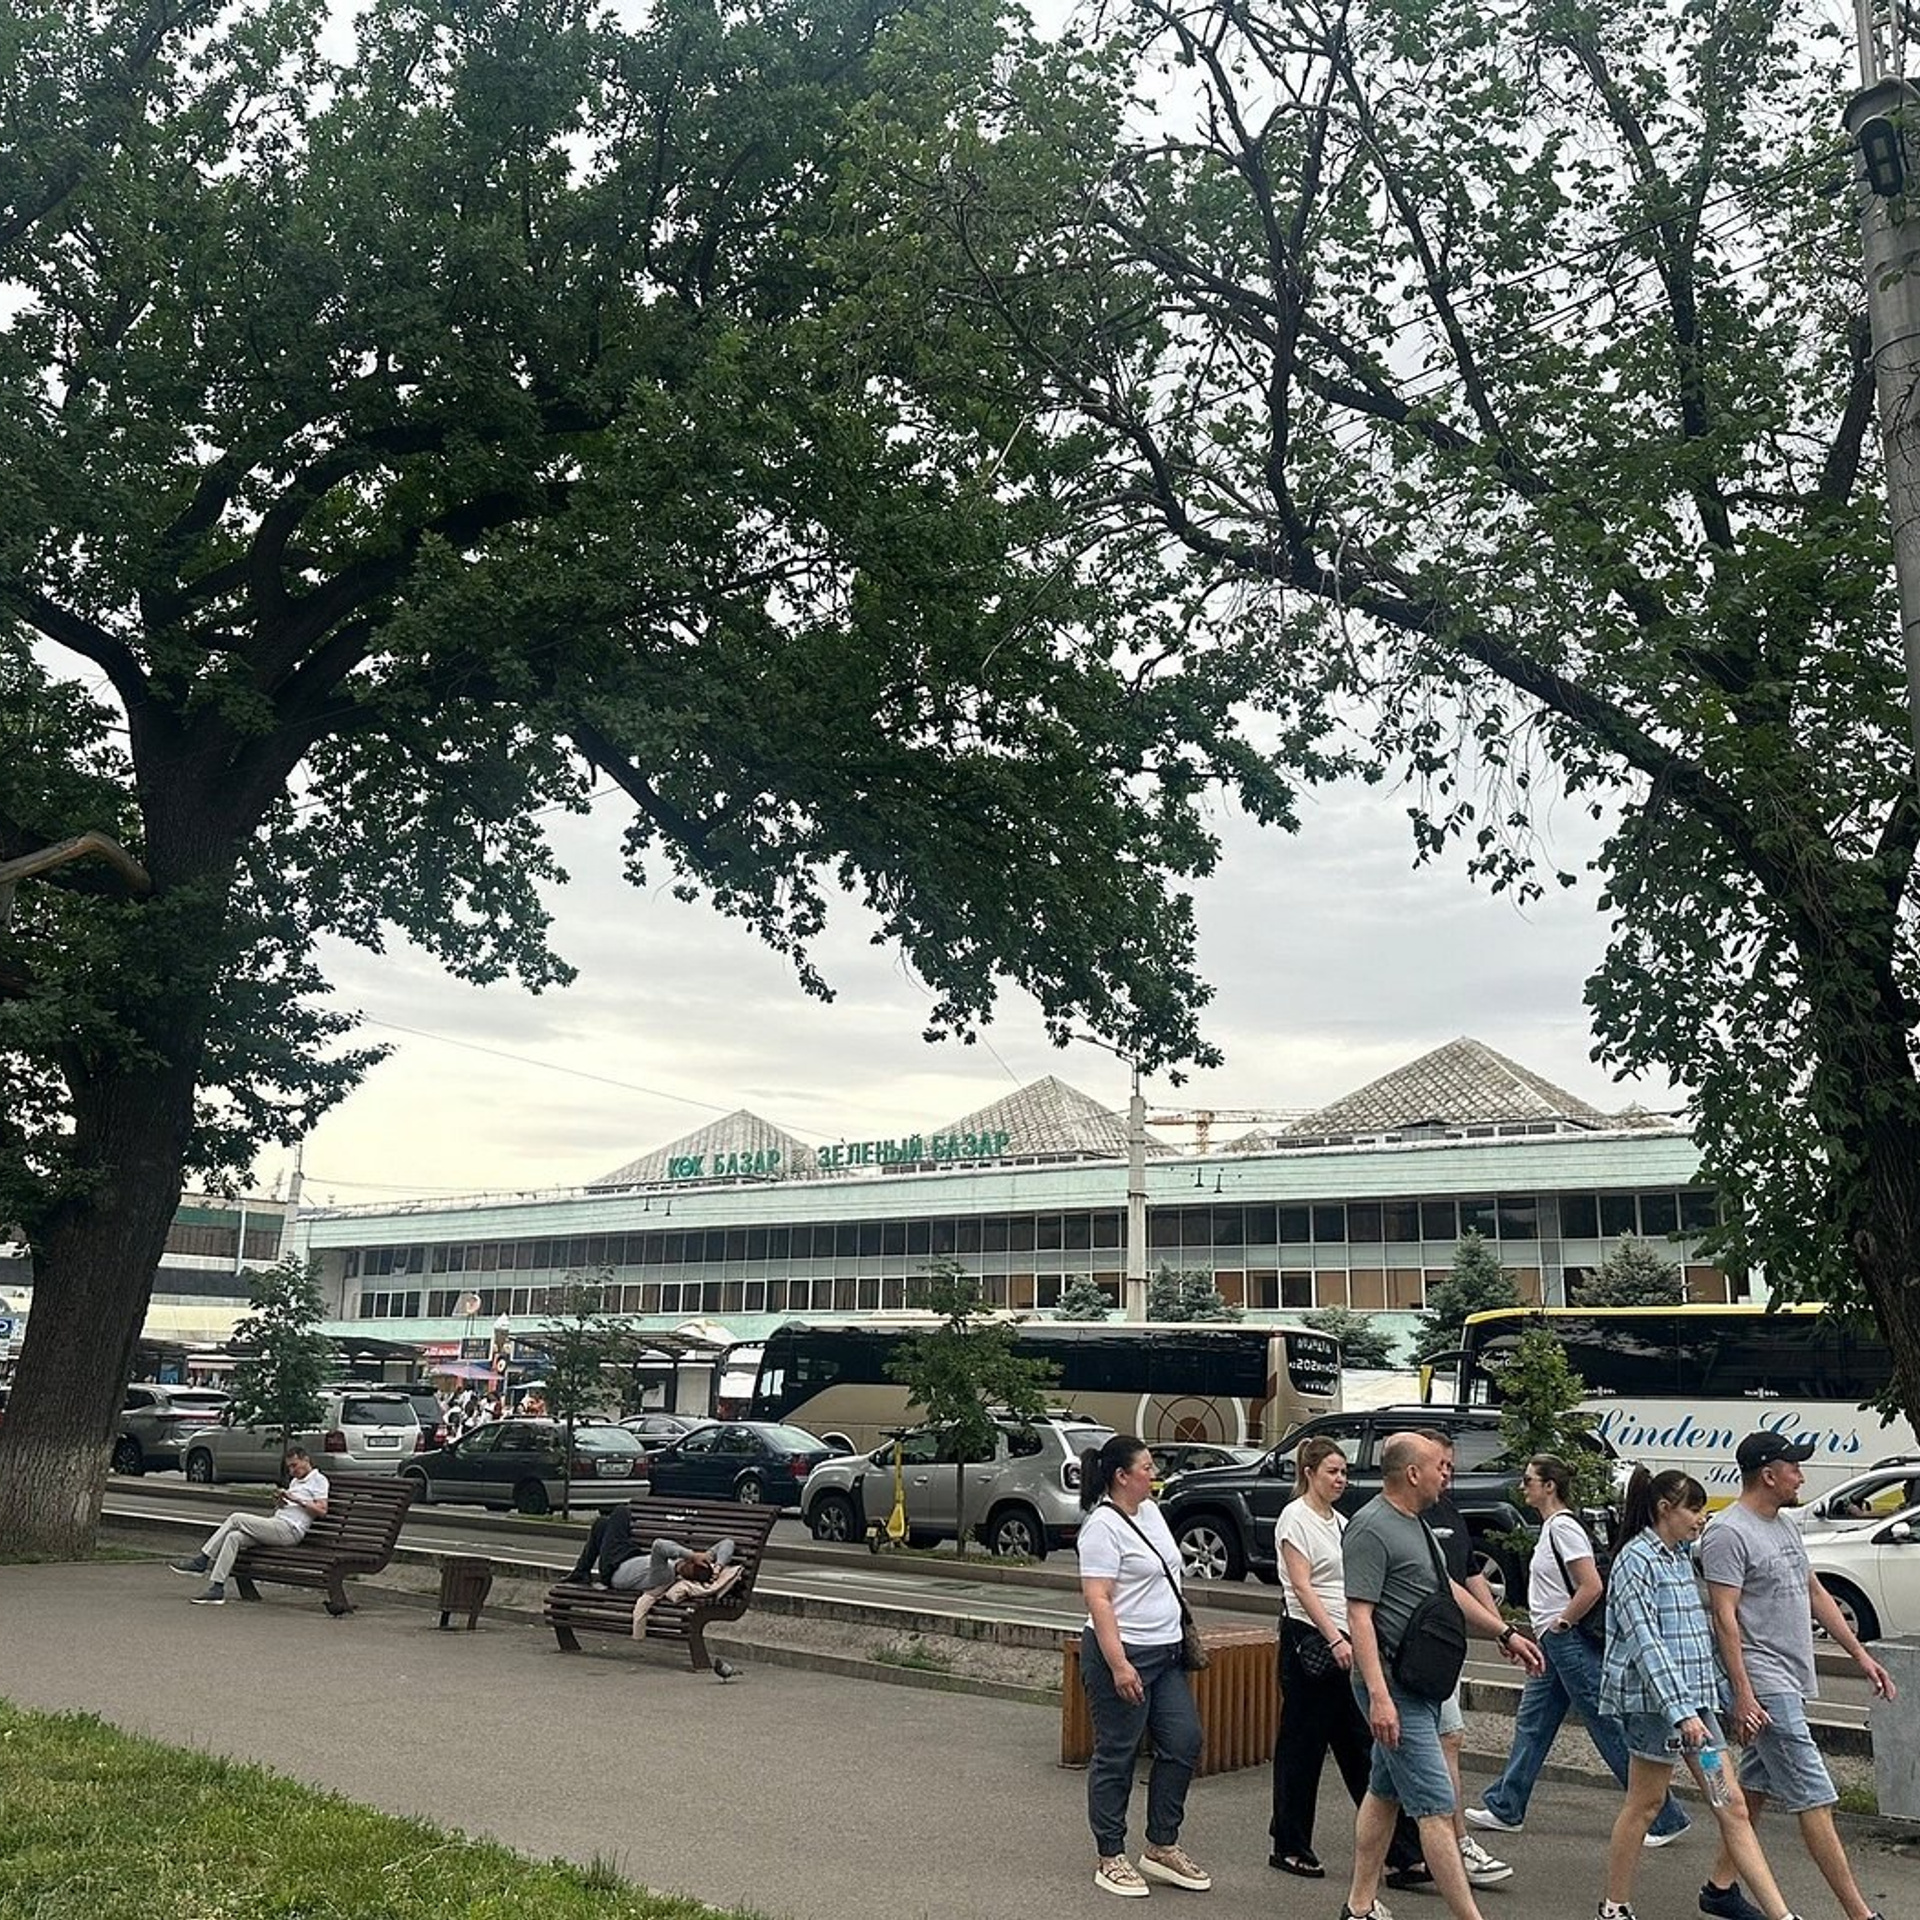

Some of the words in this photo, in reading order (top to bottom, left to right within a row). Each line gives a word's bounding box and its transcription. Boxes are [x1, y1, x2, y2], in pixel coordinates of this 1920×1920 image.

[667, 1155, 704, 1179] КӨК
[713, 1149, 781, 1175] БАЗАР
[817, 1133, 923, 1168] ЗЕЛЕНЫЙ
[931, 1130, 1011, 1160] БАЗАР
